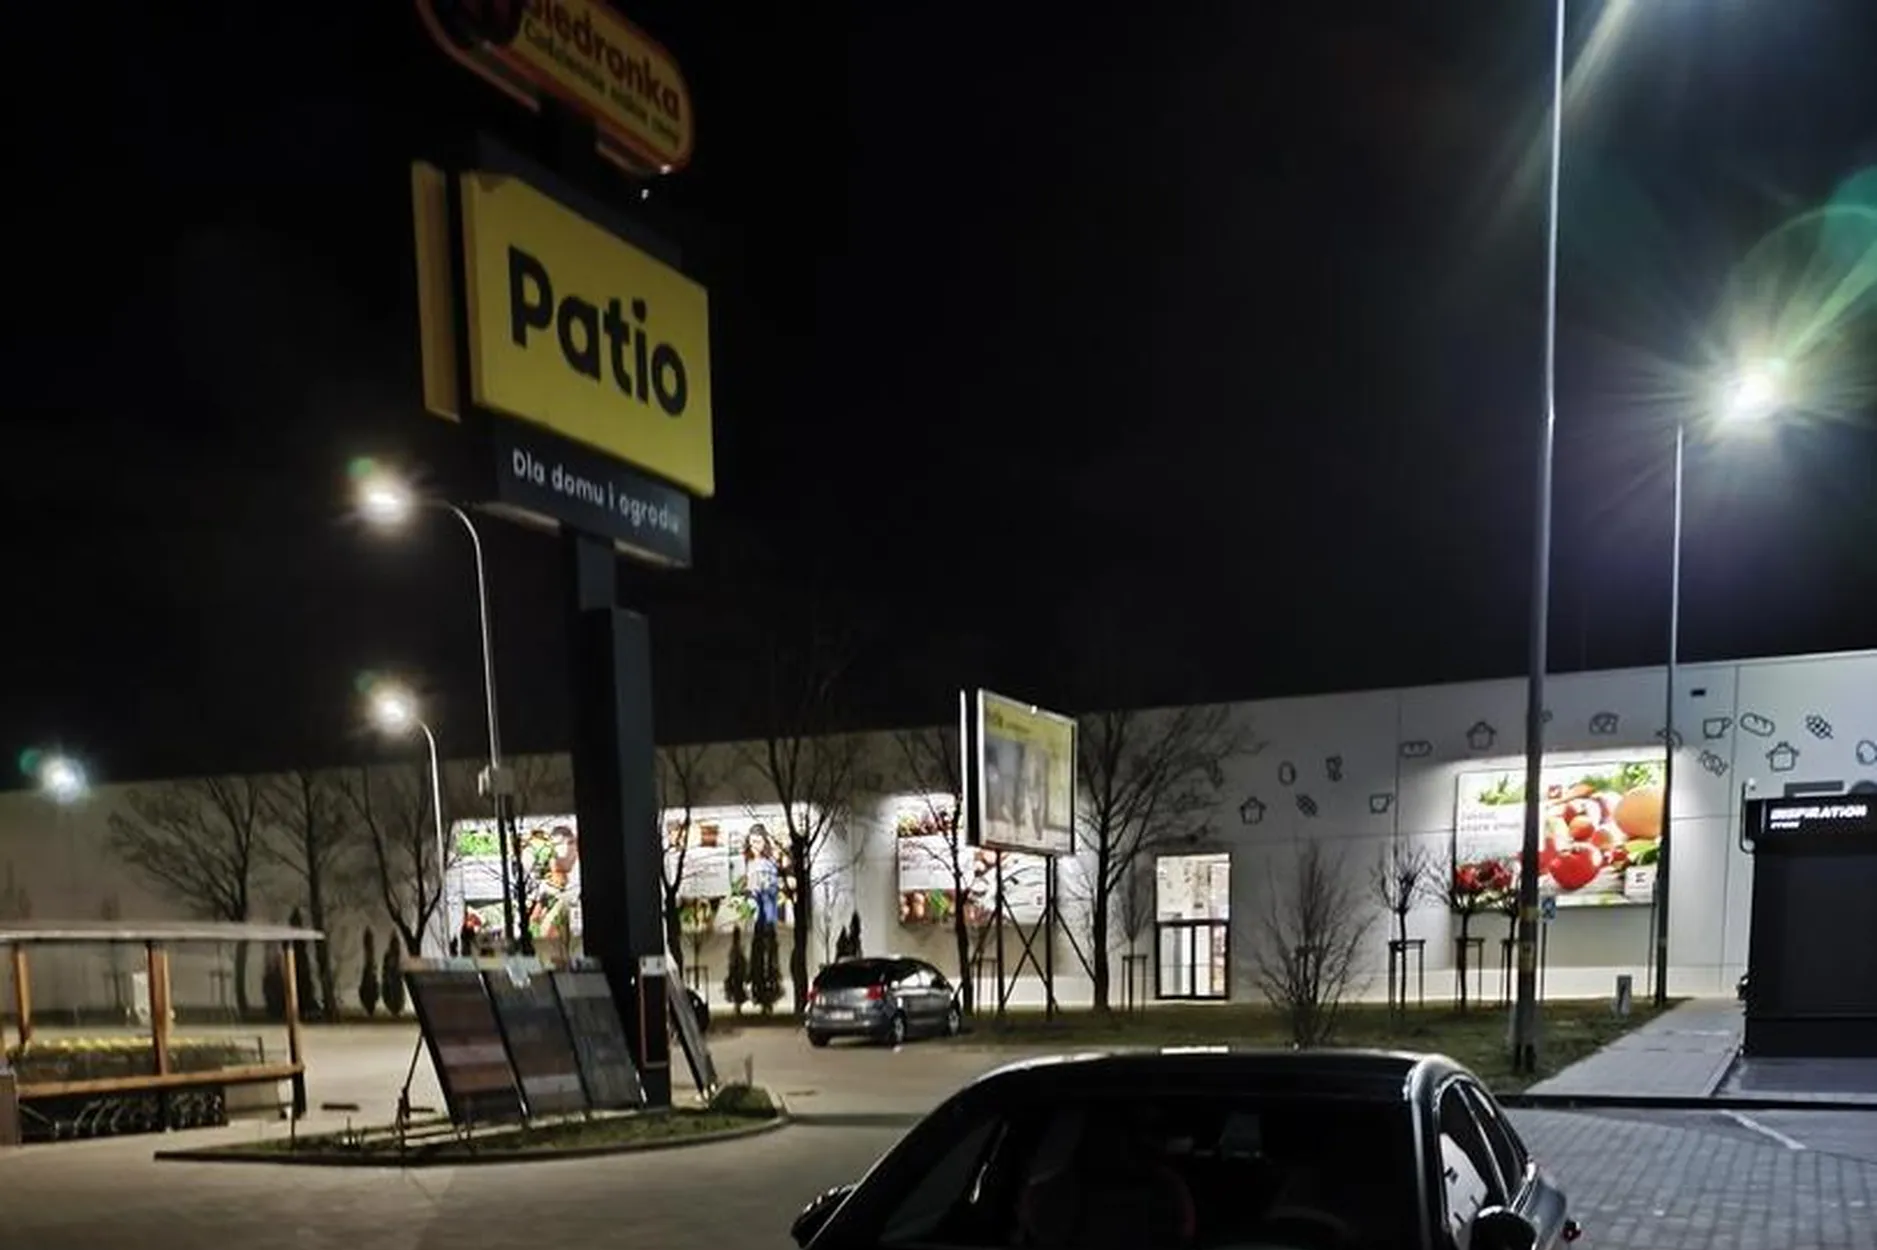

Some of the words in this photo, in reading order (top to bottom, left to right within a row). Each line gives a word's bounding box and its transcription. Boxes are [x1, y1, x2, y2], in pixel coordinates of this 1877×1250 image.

[508, 243, 690, 417] Patio
[513, 448, 545, 485] Dla
[552, 465, 604, 506] domu
[608, 481, 615, 509] i
